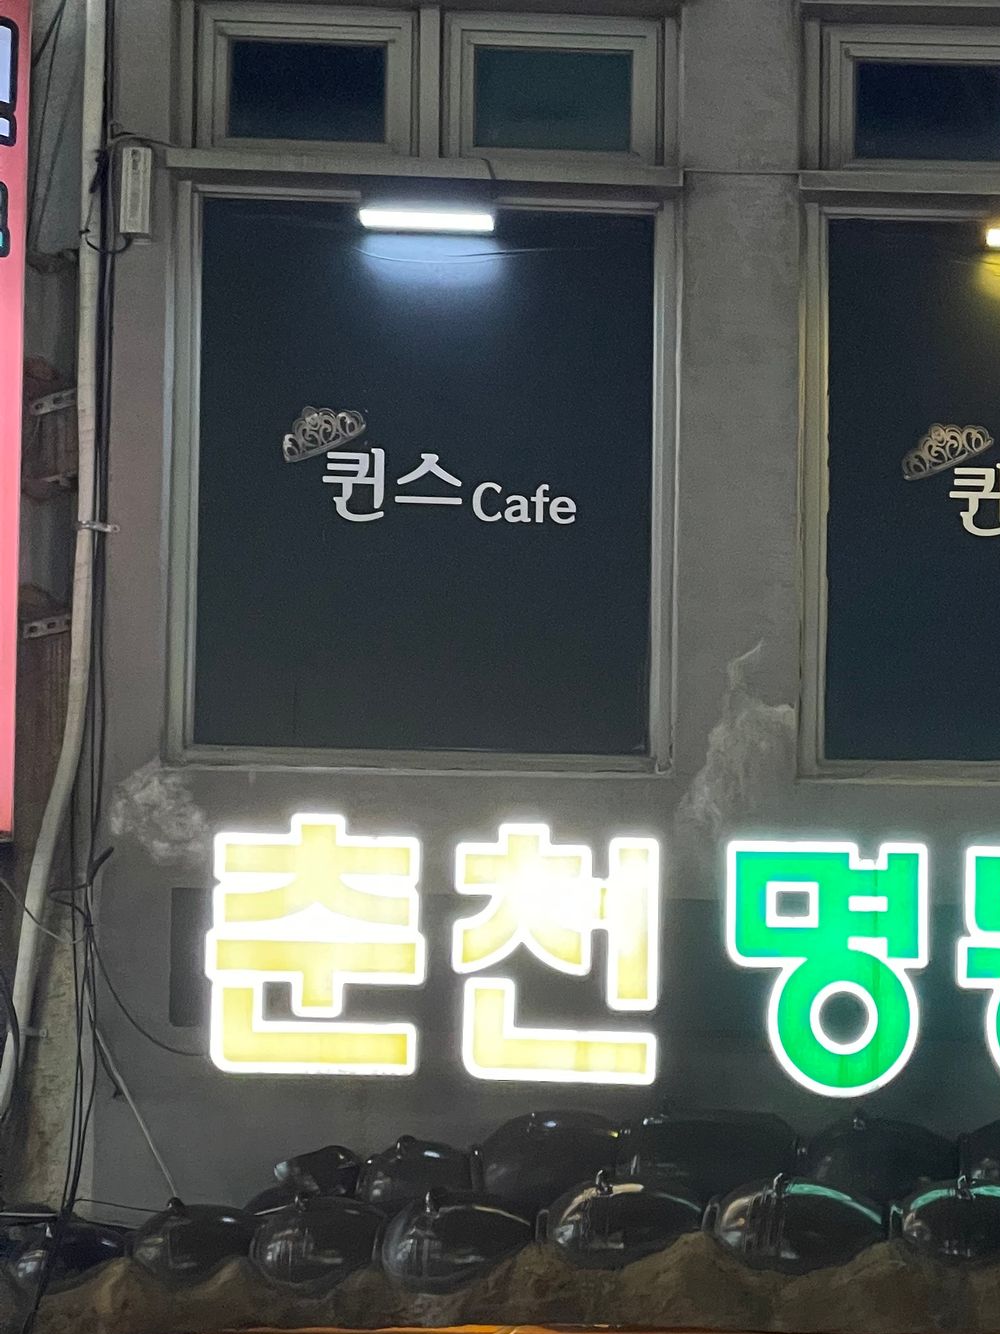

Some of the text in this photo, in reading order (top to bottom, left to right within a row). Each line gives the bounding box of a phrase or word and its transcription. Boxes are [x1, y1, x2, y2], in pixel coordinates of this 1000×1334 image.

[323, 447, 577, 525] 퀸스 Cafe
[206, 812, 661, 1085] 춘천
